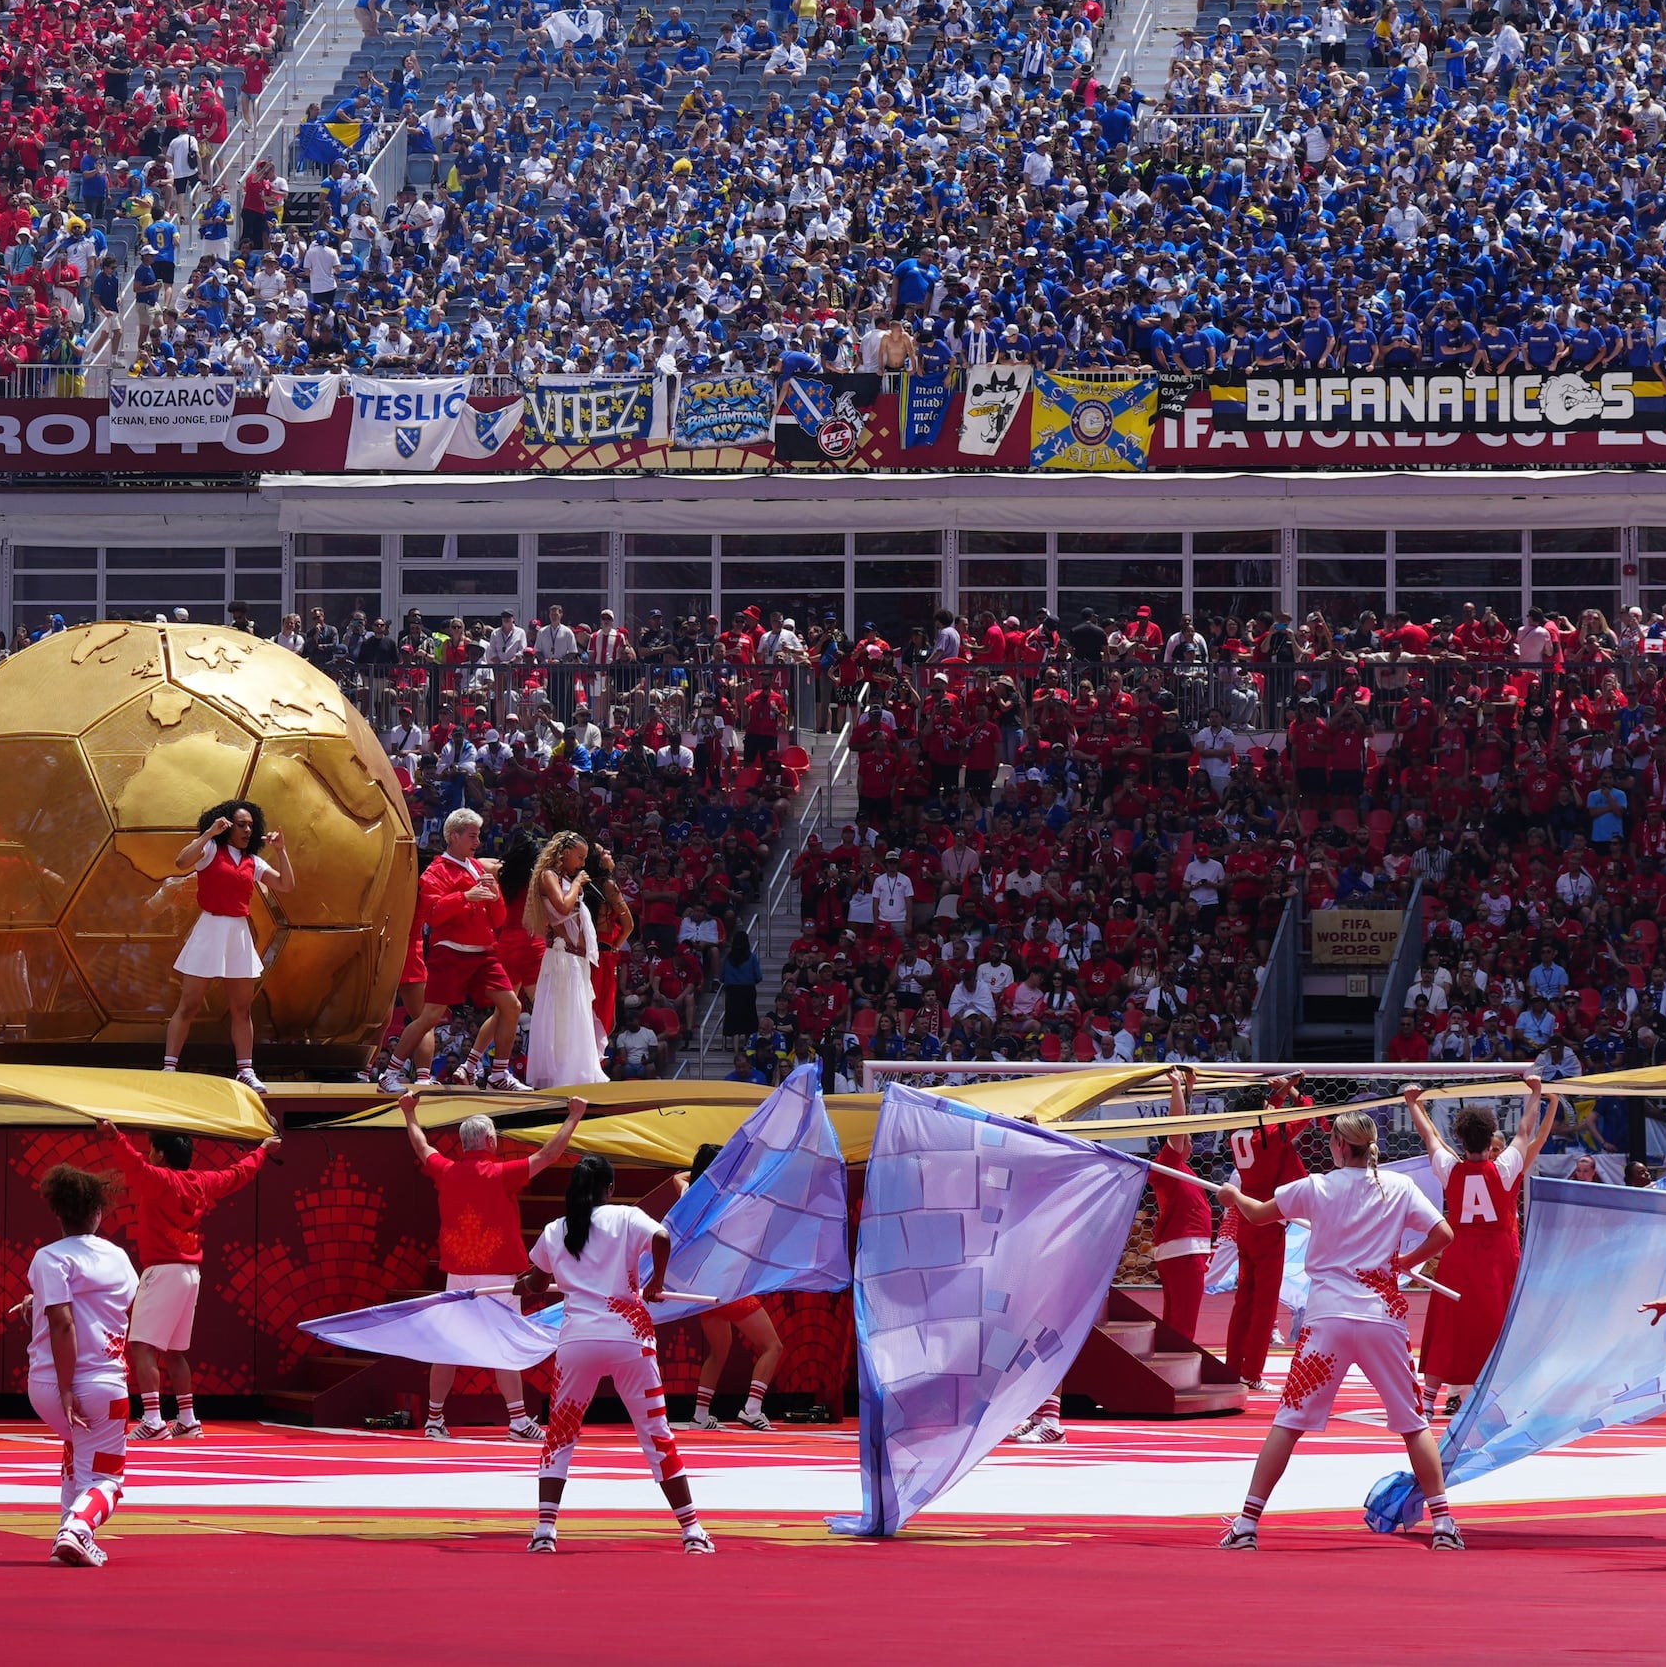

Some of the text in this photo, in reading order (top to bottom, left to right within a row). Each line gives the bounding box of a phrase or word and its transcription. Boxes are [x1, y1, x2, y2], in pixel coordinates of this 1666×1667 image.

[156, 234, 165, 247] 9
[127, 388, 215, 408] KOZARAC
[690, 377, 761, 404] RAJA
[1246, 374, 1633, 423] BHFANATICS
[356, 384, 466, 421] TESLIĆ
[717, 403, 730, 412] IZ
[111, 416, 147, 426] KENAN,
[149, 415, 169, 425] ENO
[170, 415, 207, 426] JONGE,
[524, 386, 641, 439] VITEZ
[713, 423, 743, 441] NY
[1341, 919, 1372, 930] FIFA
[1317, 931, 1398, 943] WORLD CUP
[1332, 944, 1382, 956] 2026
[1349, 979, 1367, 994] EXIT
[1460, 1174, 1498, 1223] A
